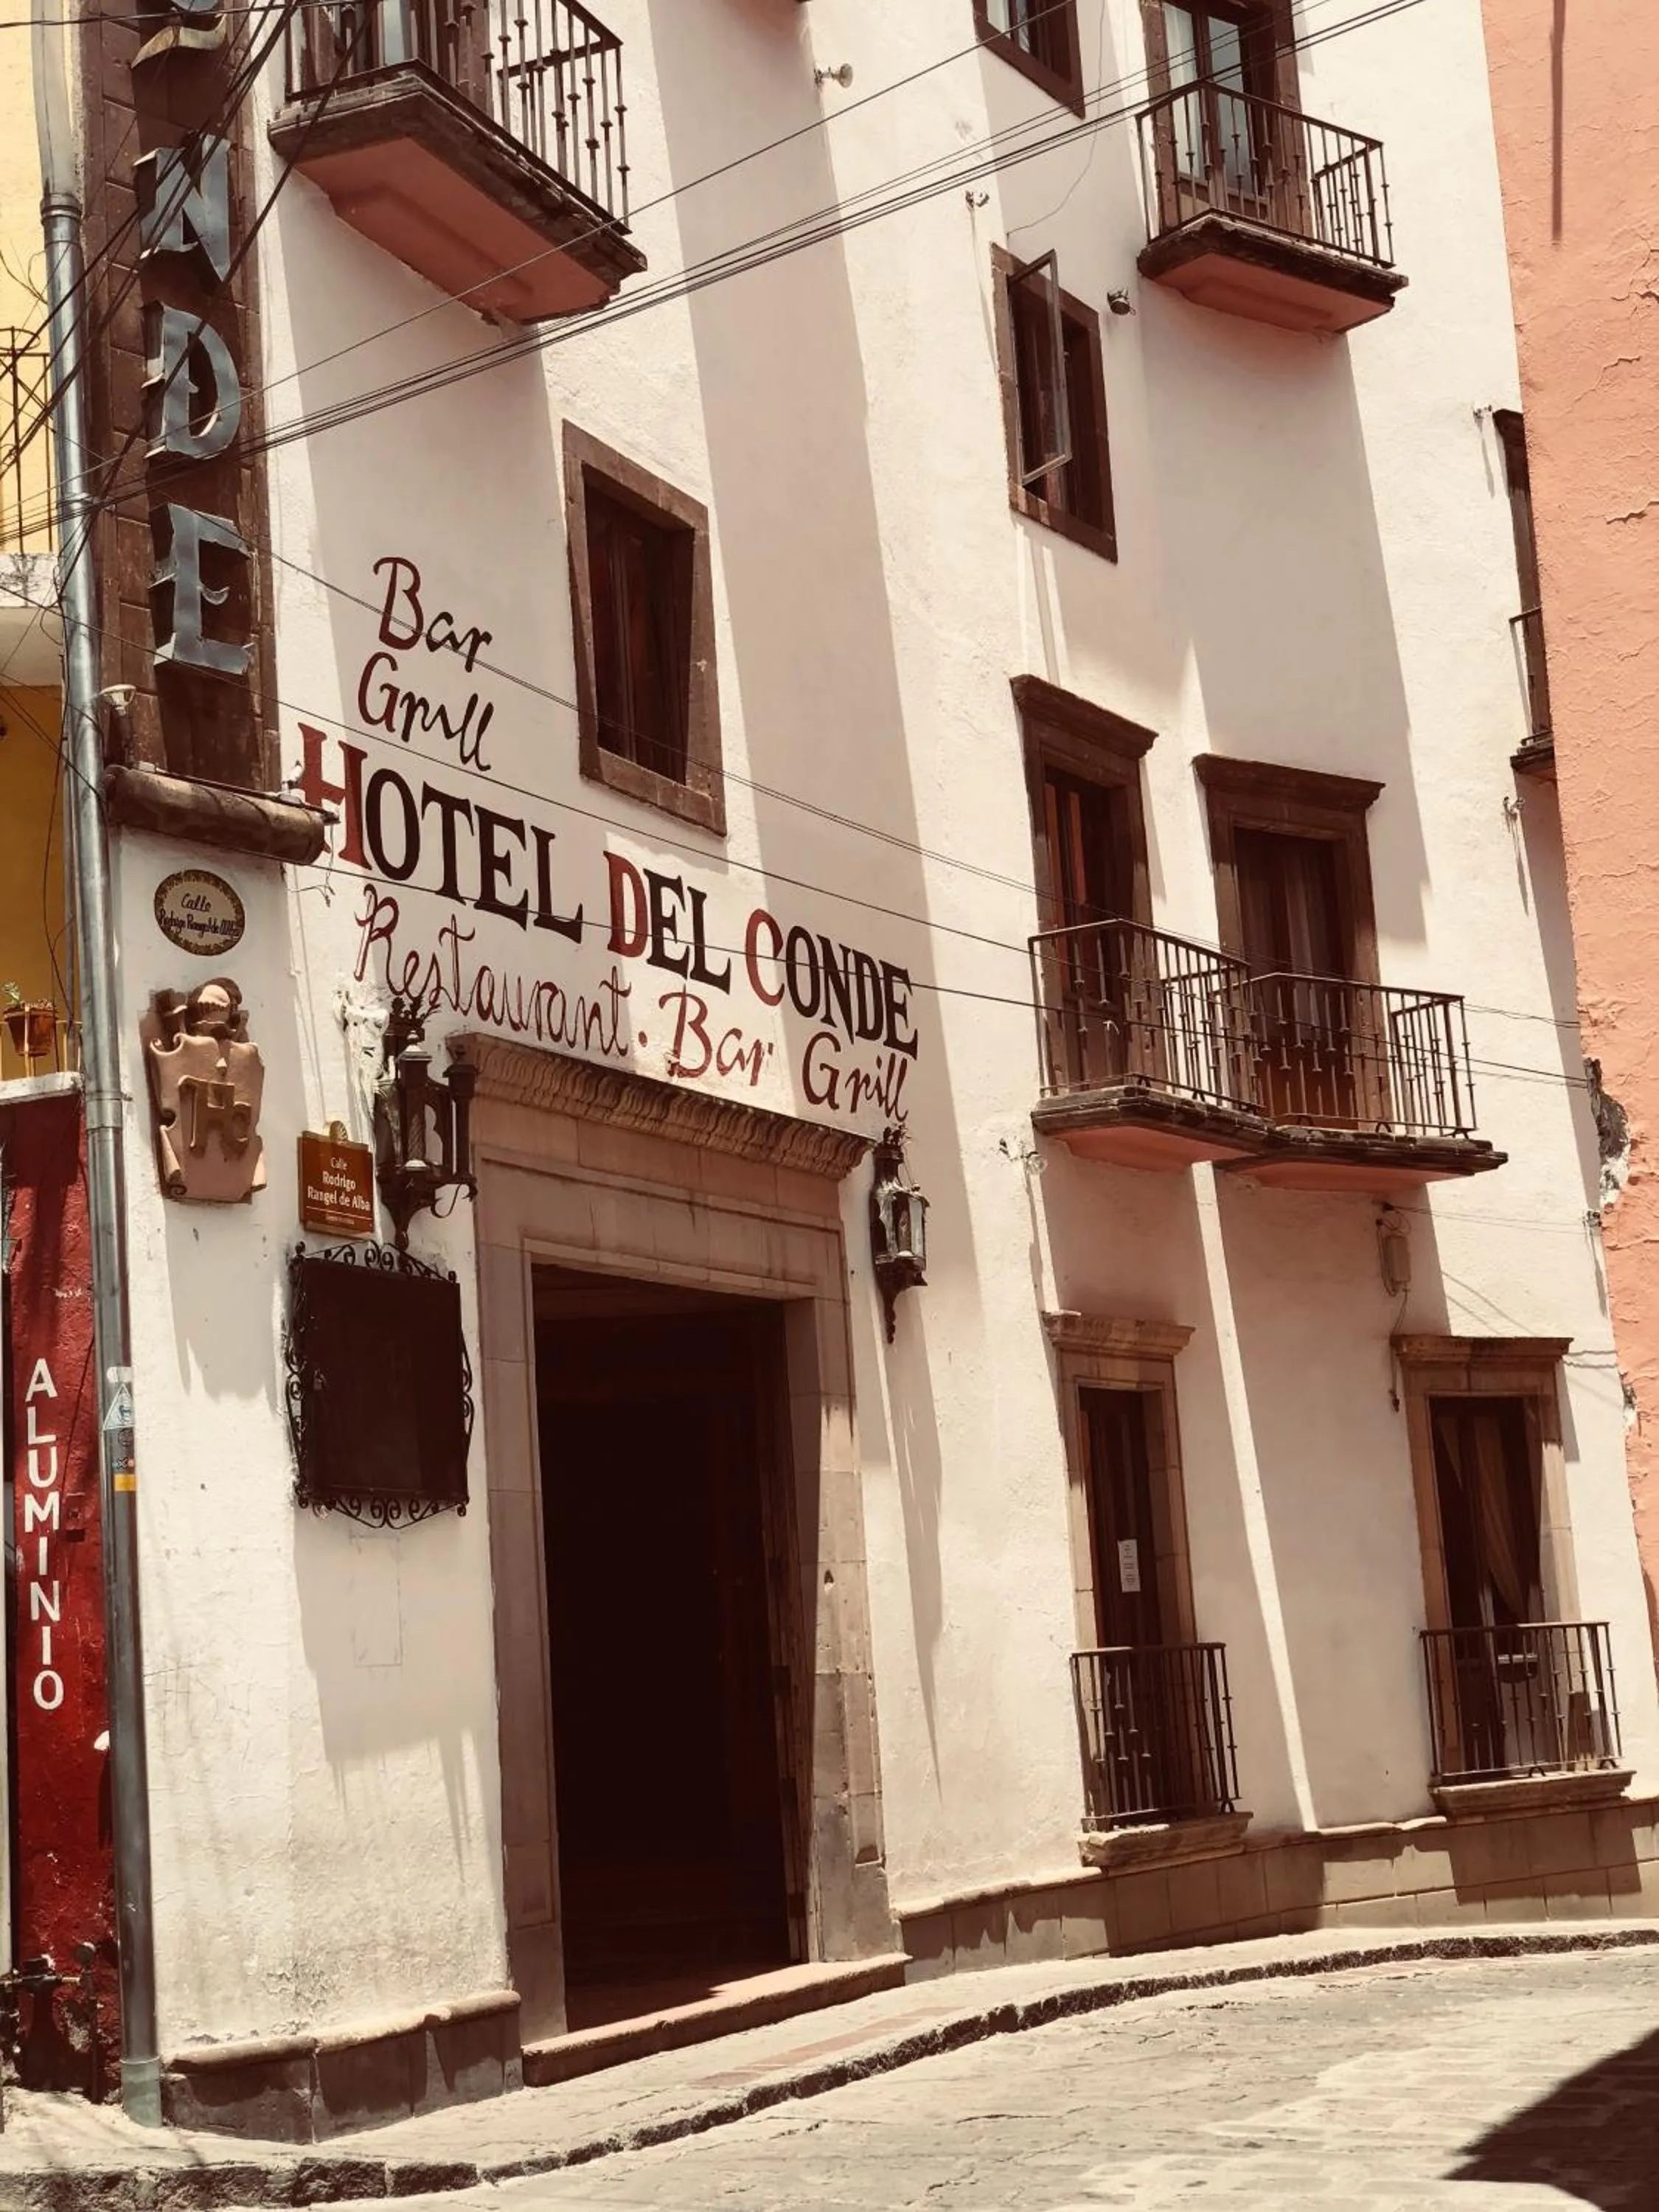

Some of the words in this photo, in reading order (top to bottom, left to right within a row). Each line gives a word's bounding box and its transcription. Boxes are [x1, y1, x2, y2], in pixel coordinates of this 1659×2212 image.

[373, 557, 493, 672] Bar
[358, 652, 494, 771] Grill
[181, 892, 212, 912] Calle
[297, 723, 583, 944] HOTEL
[603, 850, 731, 995] DEL
[745, 908, 918, 1060] CONDE
[658, 983, 773, 1088] Bar
[802, 1031, 908, 1121] Grill
[307, 1185, 338, 1206] Rangel
[339, 1191, 350, 1207] de
[352, 1194, 371, 1211] Alba
[322, 1170, 356, 1192] Rodrigo
[330, 1157, 348, 1171] Calle
[24, 1357, 64, 1711] ALUMINIO
